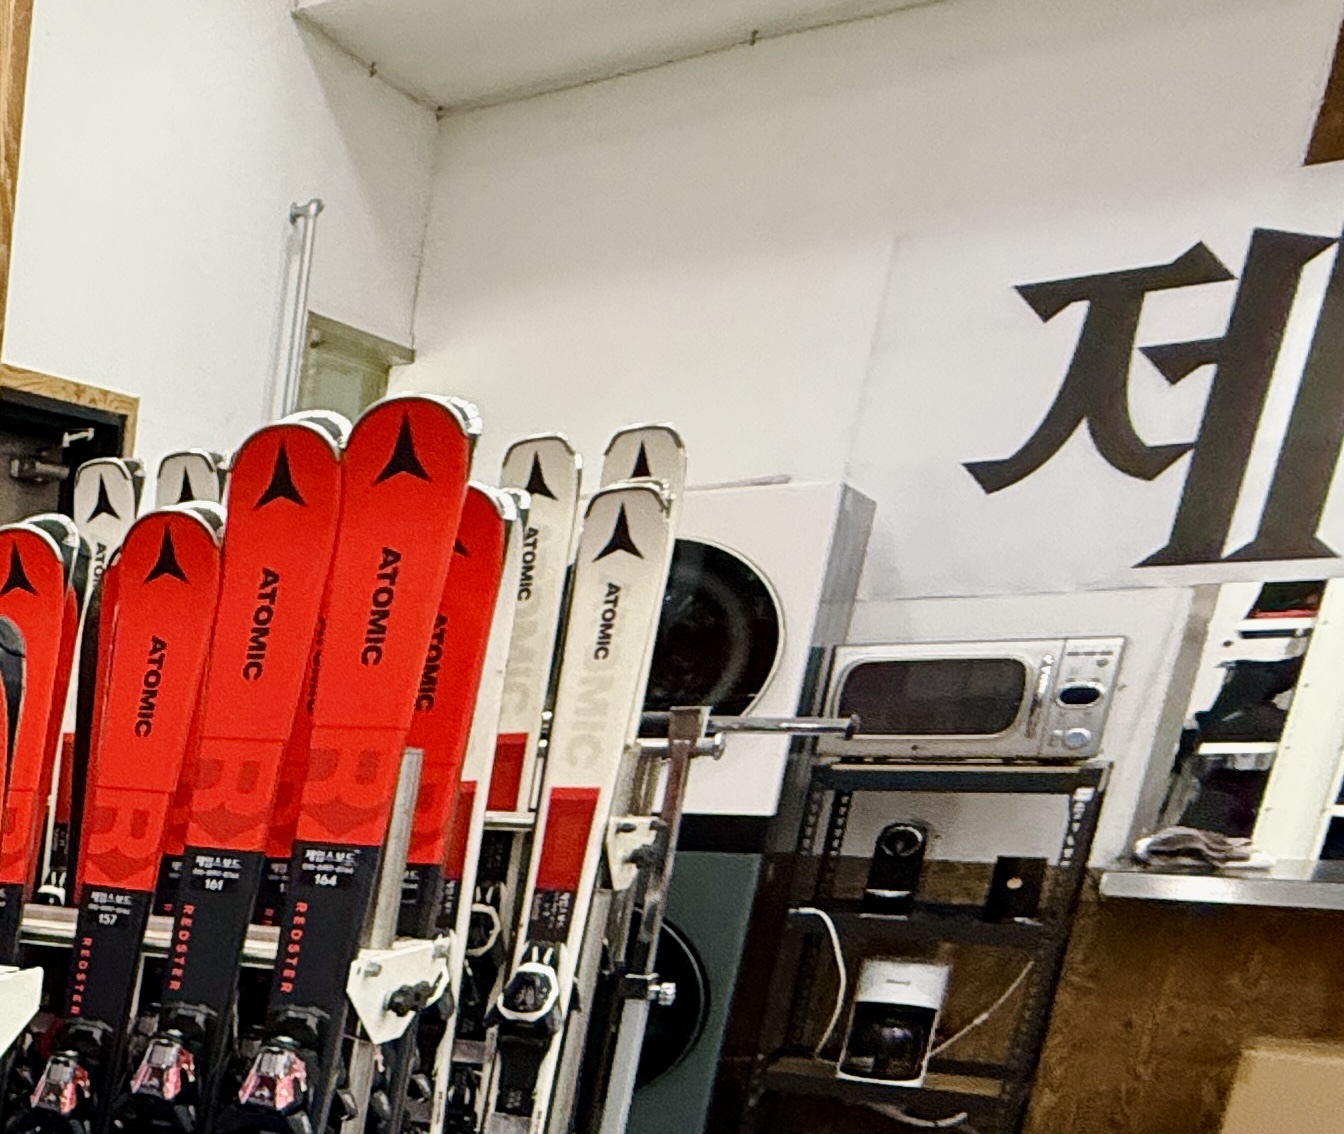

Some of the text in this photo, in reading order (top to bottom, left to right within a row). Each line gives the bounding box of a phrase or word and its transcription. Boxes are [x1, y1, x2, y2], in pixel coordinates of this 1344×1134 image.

[517, 526, 539, 602] ATOMIC
[242, 567, 280, 681] ATOMIC
[360, 546, 403, 668] ATOMIC
[594, 581, 622, 661] ATOMIC
[134, 634, 167, 738] ATOMIC
[415, 613, 448, 712] ATOMIC
[98, 913, 117, 926] 157
[204, 878, 224, 891] 161
[314, 873, 338, 886] 164
[69, 937, 93, 1015] REDSTER
[169, 904, 196, 991] REDSTER
[280, 901, 308, 993] REDSTER
